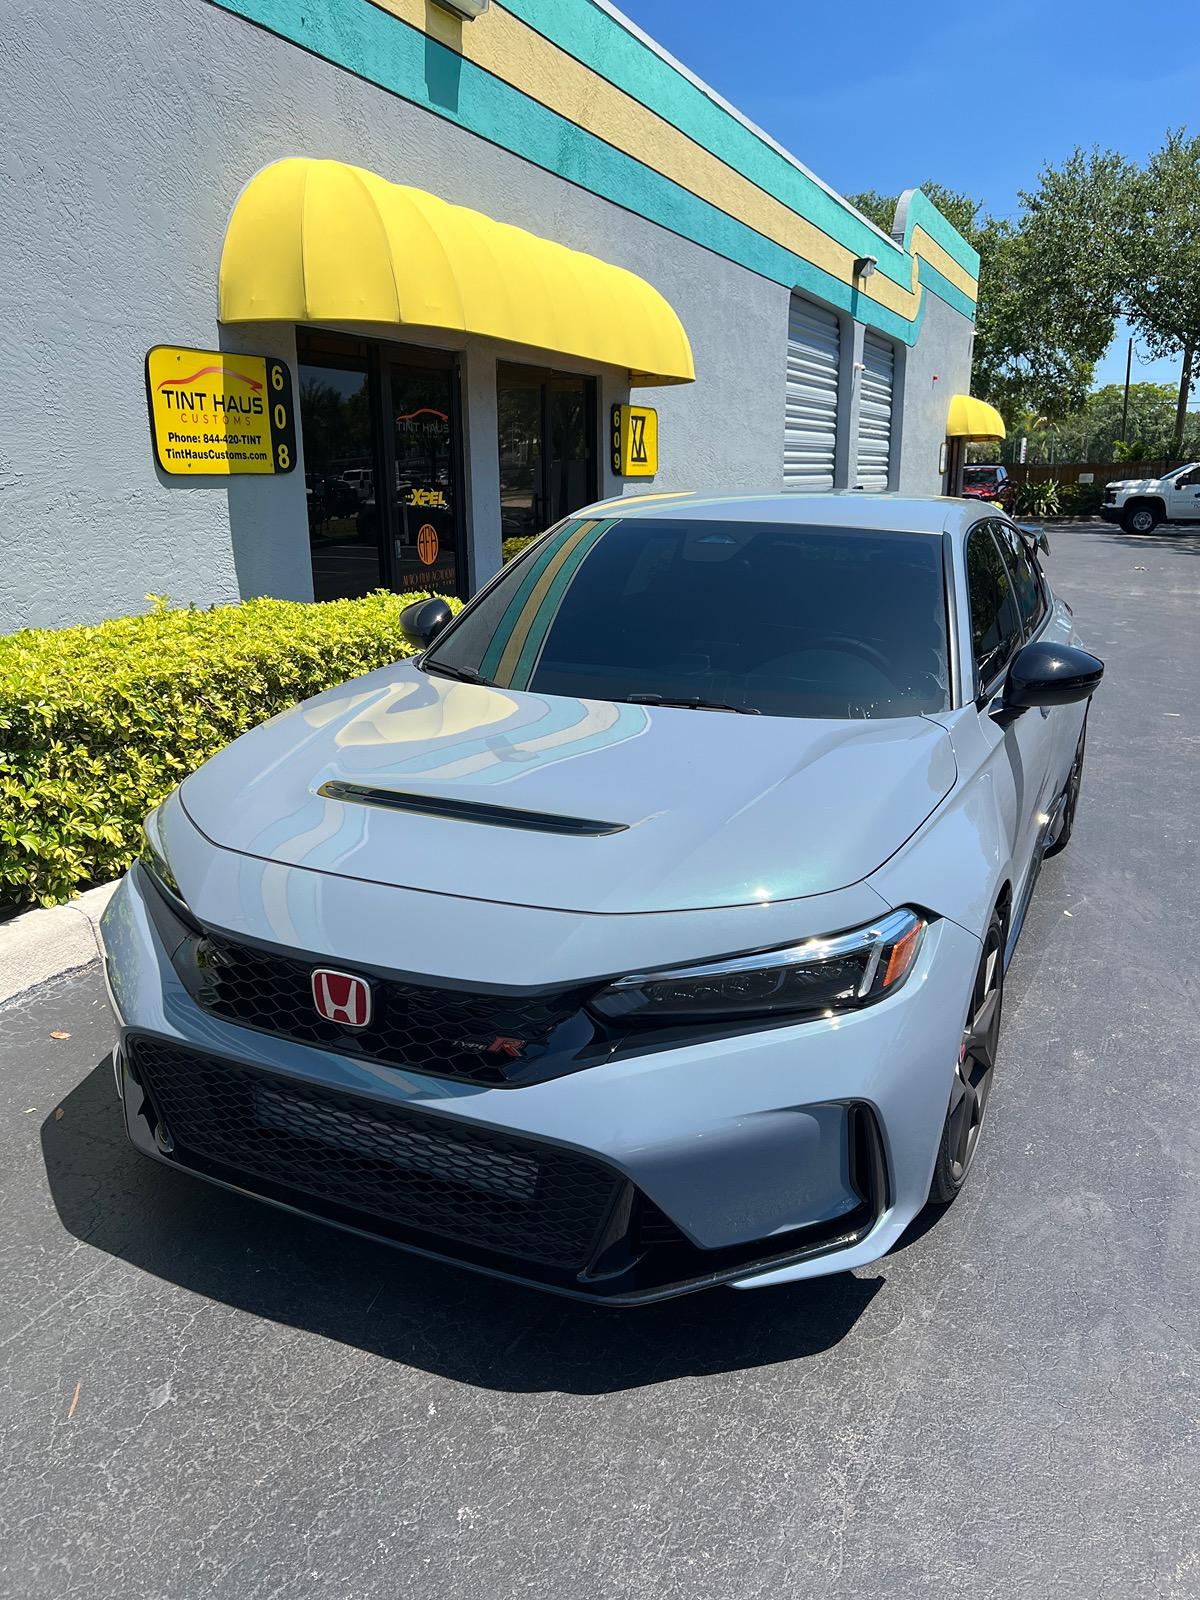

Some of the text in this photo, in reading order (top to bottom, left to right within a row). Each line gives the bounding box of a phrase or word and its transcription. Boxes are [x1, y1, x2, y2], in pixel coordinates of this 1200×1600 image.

[161, 390, 264, 415] TINT HAUS
[180, 413, 251, 426] CUSTOMS
[271, 365, 290, 469] 608
[168, 432, 262, 445] Phone: 844-420-TINT
[165, 448, 267, 461] TintHausCustoms.com
[411, 488, 446, 506] XPEL
